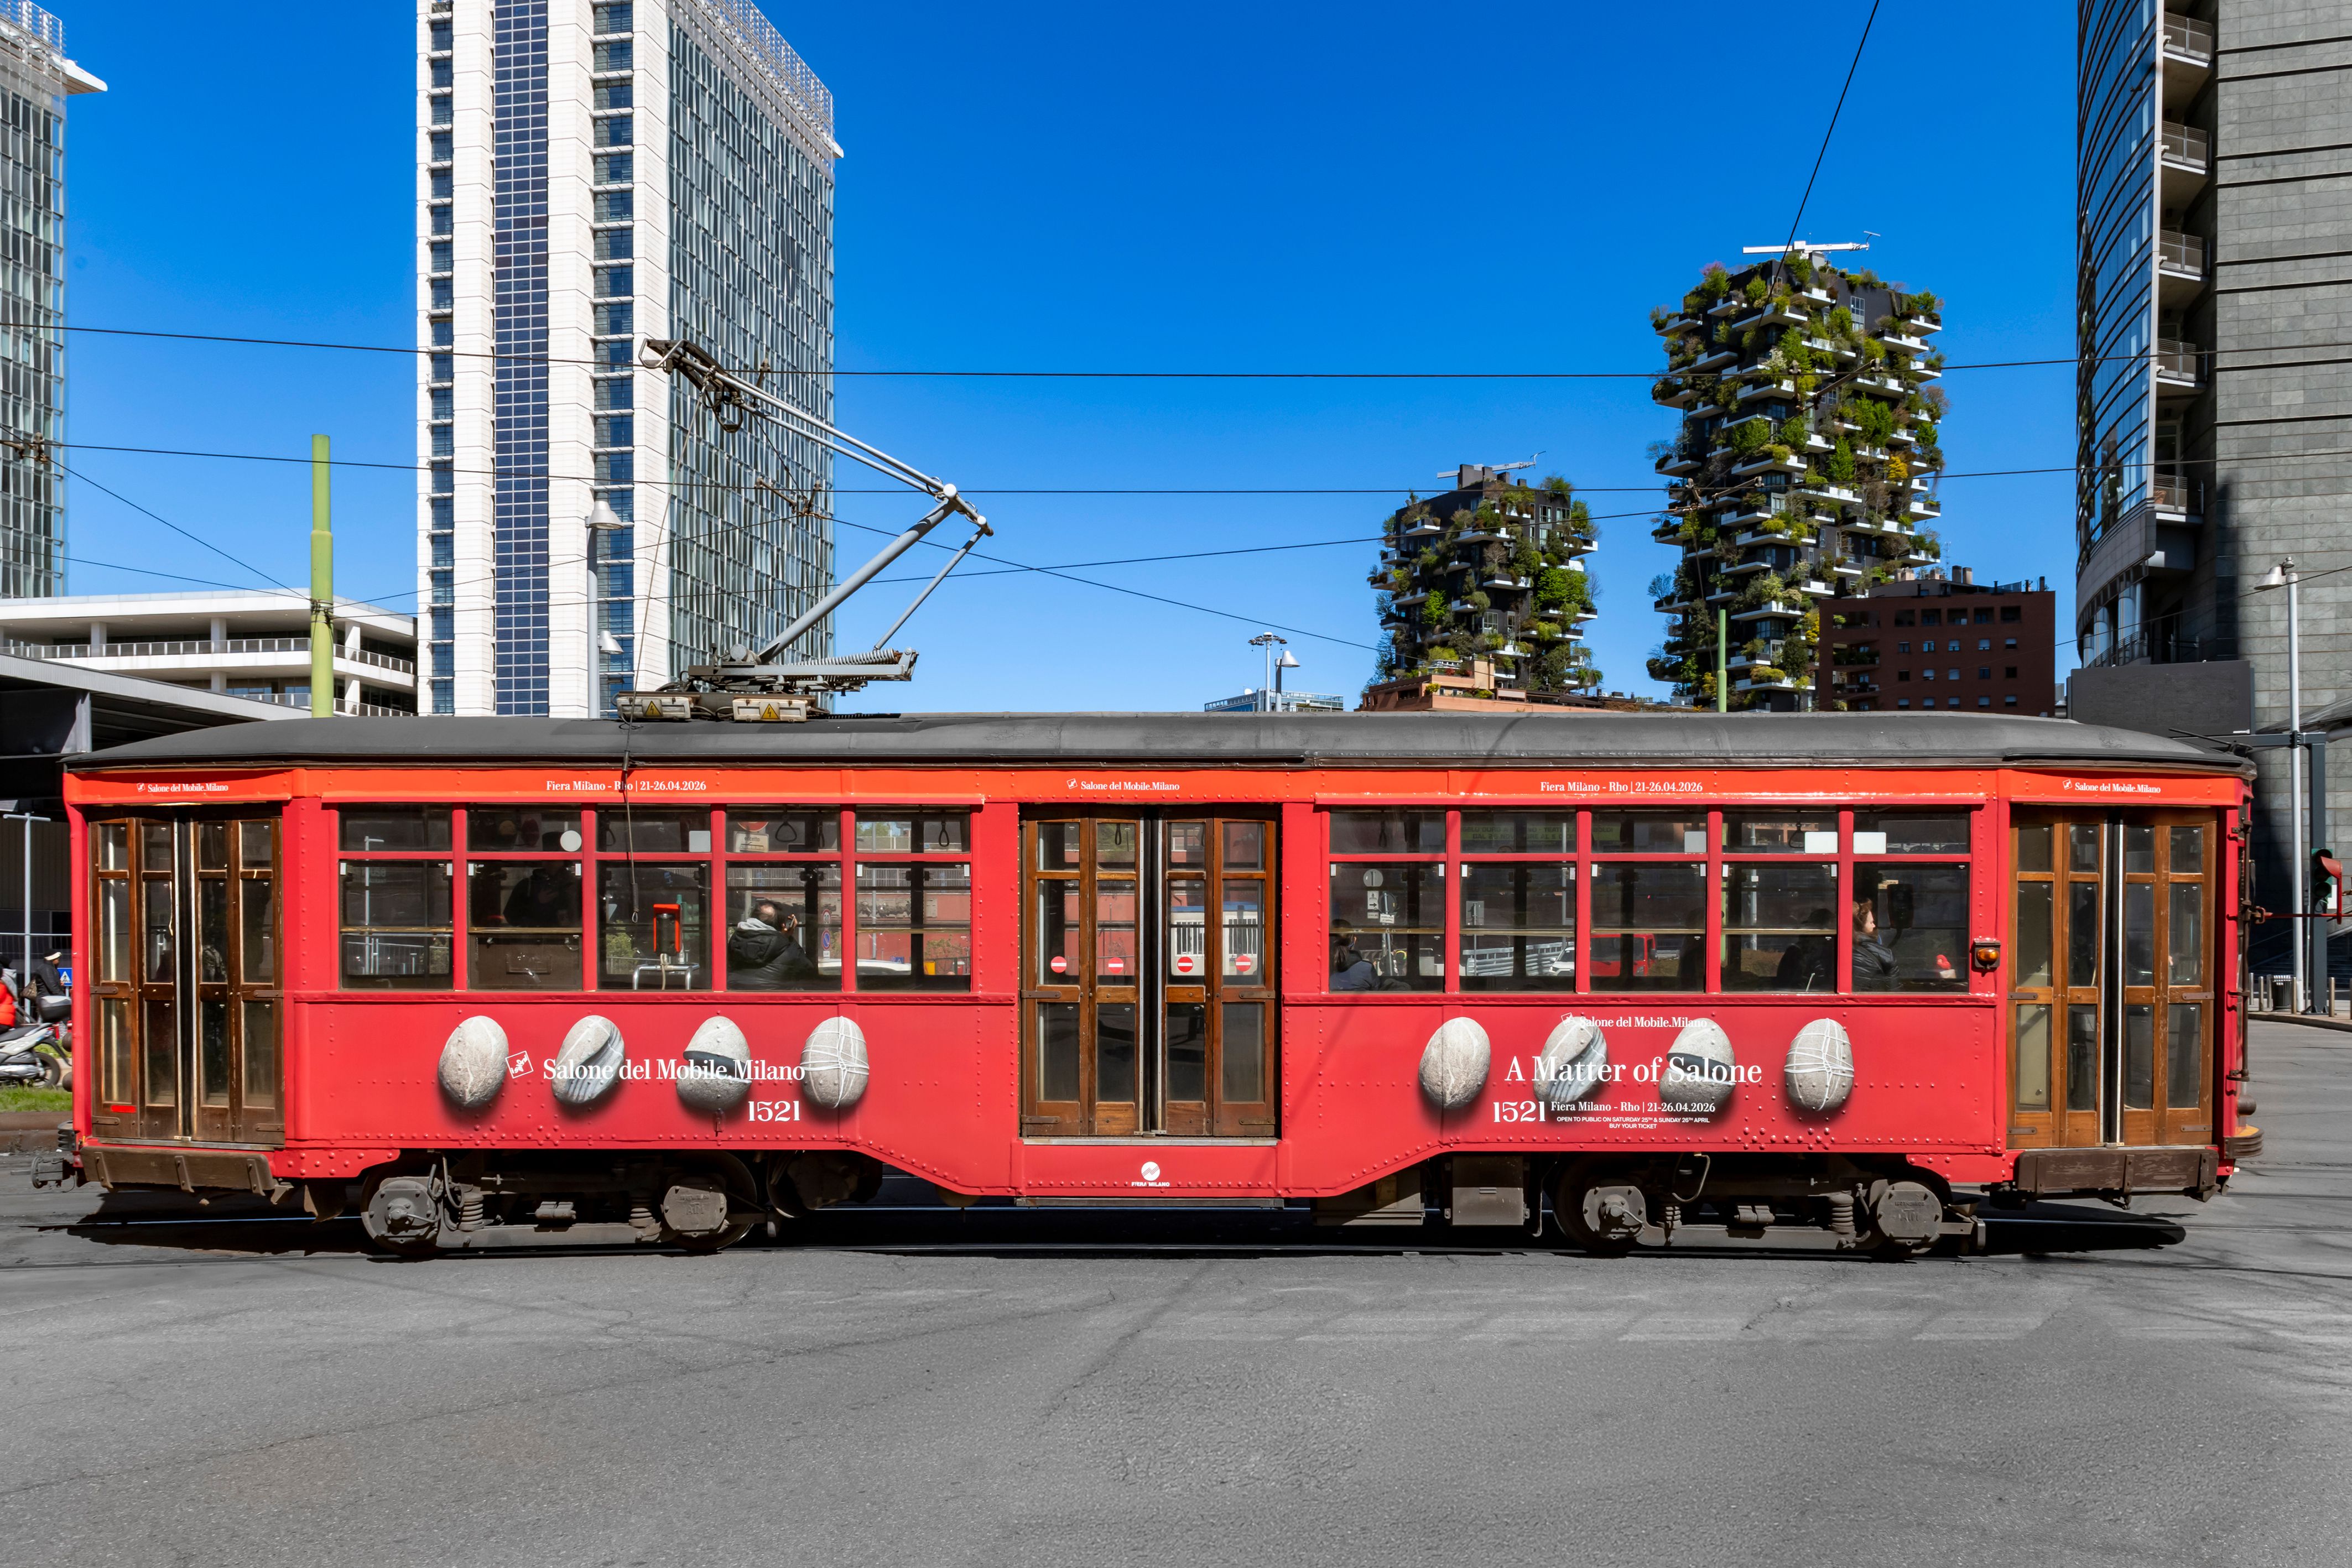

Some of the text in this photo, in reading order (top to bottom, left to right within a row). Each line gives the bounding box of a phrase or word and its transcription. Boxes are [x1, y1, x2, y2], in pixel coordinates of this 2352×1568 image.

[148, 784, 169, 792] Salone
[170, 784, 180, 792] del
[546, 780, 570, 790] Fiera
[573, 780, 606, 790] Milano
[614, 780, 633, 790] Rho
[640, 780, 706, 790] 21-26.04.2026
[1081, 781, 1180, 790] Salone del Mobile.Milano
[1540, 782, 1565, 791] Fiera
[1567, 782, 1600, 791] Milano
[1609, 782, 1628, 791] Rho
[1635, 782, 1703, 792] 21-26.04.2026
[2075, 782, 2161, 793] Salone del Mobile.Milano
[1580, 1016, 1708, 1028] Salone del Mobile.Milano
[543, 1059, 613, 1080] Salone
[618, 1059, 651, 1080] del
[656, 1059, 805, 1080] Mobile.Milano
[1504, 1056, 1762, 1083] A Matter of Salone
[748, 1100, 800, 1122] 1521
[1493, 1101, 1546, 1123] 1521
[1551, 1101, 1576, 1111] Fiera
[1578, 1101, 1611, 1111] Milano
[1620, 1102, 1640, 1111] Rho
[1647, 1102, 1715, 1112] 21-26.04.2026
